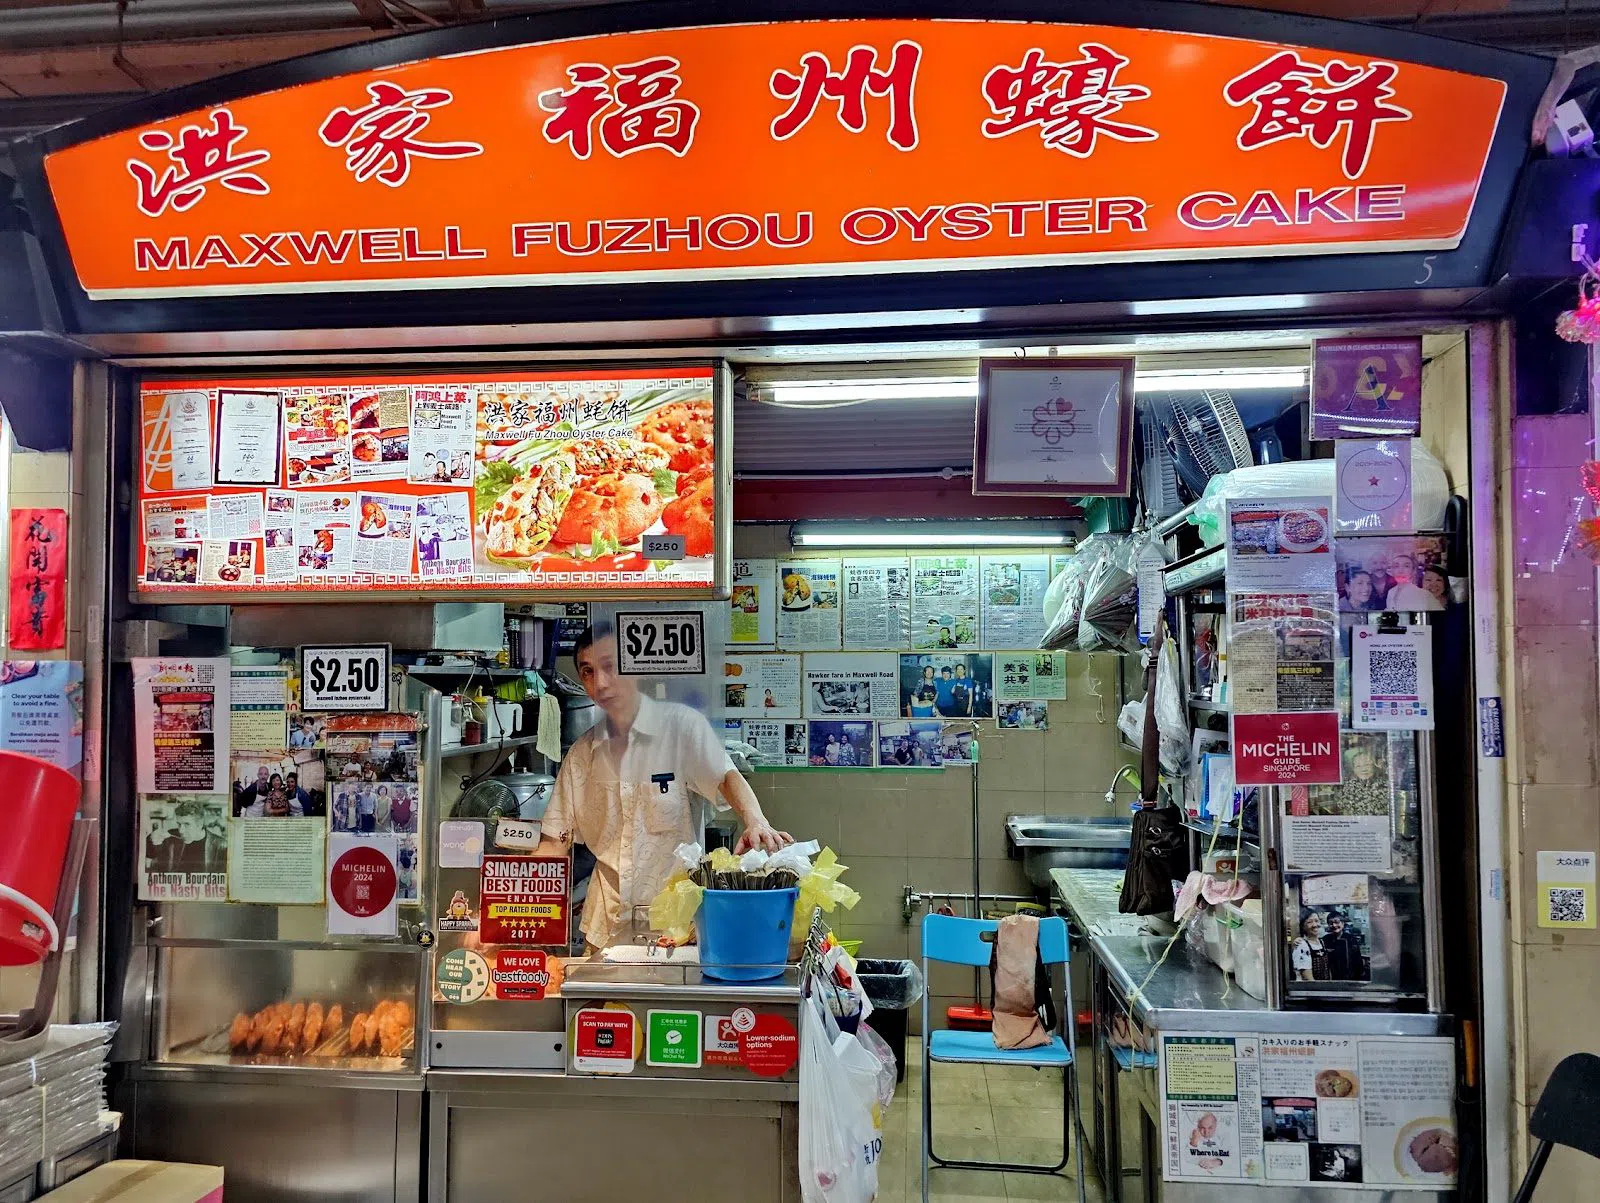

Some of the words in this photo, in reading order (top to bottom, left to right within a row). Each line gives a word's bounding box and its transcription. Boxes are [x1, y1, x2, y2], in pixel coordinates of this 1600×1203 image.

[127, 40, 1412, 217] 洪家福州蠔餅
[134, 227, 486, 272] MAXWELL
[512, 212, 813, 257] FUZHOU
[842, 197, 1147, 245] OYSTER
[1178, 185, 1406, 230] CAKE
[485, 398, 631, 427] 洪家福州蚝饼
[486, 430, 526, 440] Maxwell
[528, 431, 541, 440] Fu
[544, 430, 571, 439] Zhou
[572, 429, 604, 440] Oyster
[608, 428, 633, 438] Cake
[626, 620, 696, 660] $2.50
[1004, 663, 1029, 672] 美食
[310, 656, 380, 695] $2.50
[1004, 675, 1029, 684] 共享
[1243, 742, 1330, 757] MICHELIN
[342, 864, 386, 872] MICHELIN
[1556, 858, 1590, 866] 大众点评
[485, 862, 565, 878] SINGAPORE
[148, 873, 182, 886] Anthony
[186, 873, 225, 884] Bourdain
[486, 879, 517, 892] BEST
[522, 879, 562, 893] FOODS
[148, 884, 165, 897] The
[171, 884, 199, 900] Nasty
[204, 884, 225, 897] Bits
[512, 930, 536, 938] 2017
[493, 969, 548, 986] bestfoody
